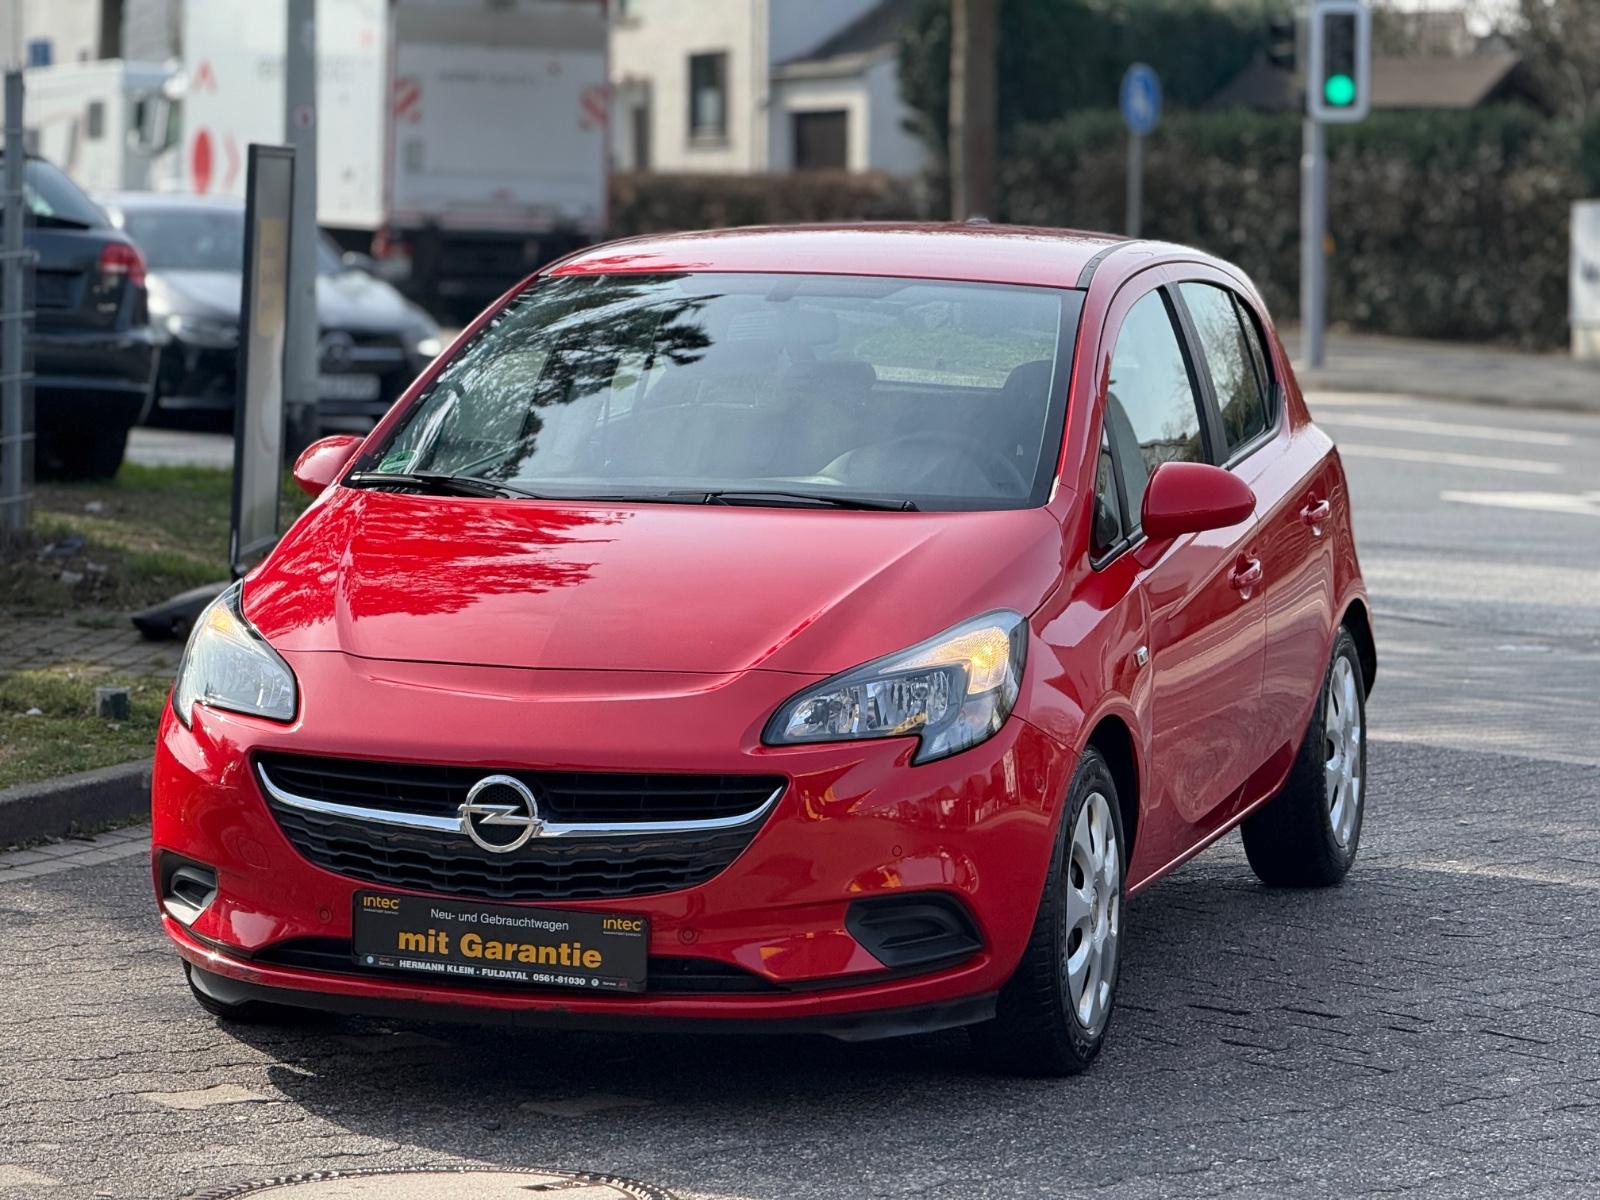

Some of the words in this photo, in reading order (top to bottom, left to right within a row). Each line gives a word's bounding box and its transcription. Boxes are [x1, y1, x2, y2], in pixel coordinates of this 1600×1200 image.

[363, 896, 399, 909] intec
[430, 909, 455, 920] Neu-
[459, 911, 477, 923] und
[480, 913, 569, 931] Gebrauchtwagen
[603, 919, 641, 931] intec
[398, 929, 449, 955] mit
[460, 933, 602, 968] Garantie
[399, 960, 444, 971] HERMANN
[447, 965, 475, 975] KLEIN
[482, 969, 528, 980] FULDATAL
[533, 973, 586, 986] 0561-81030
